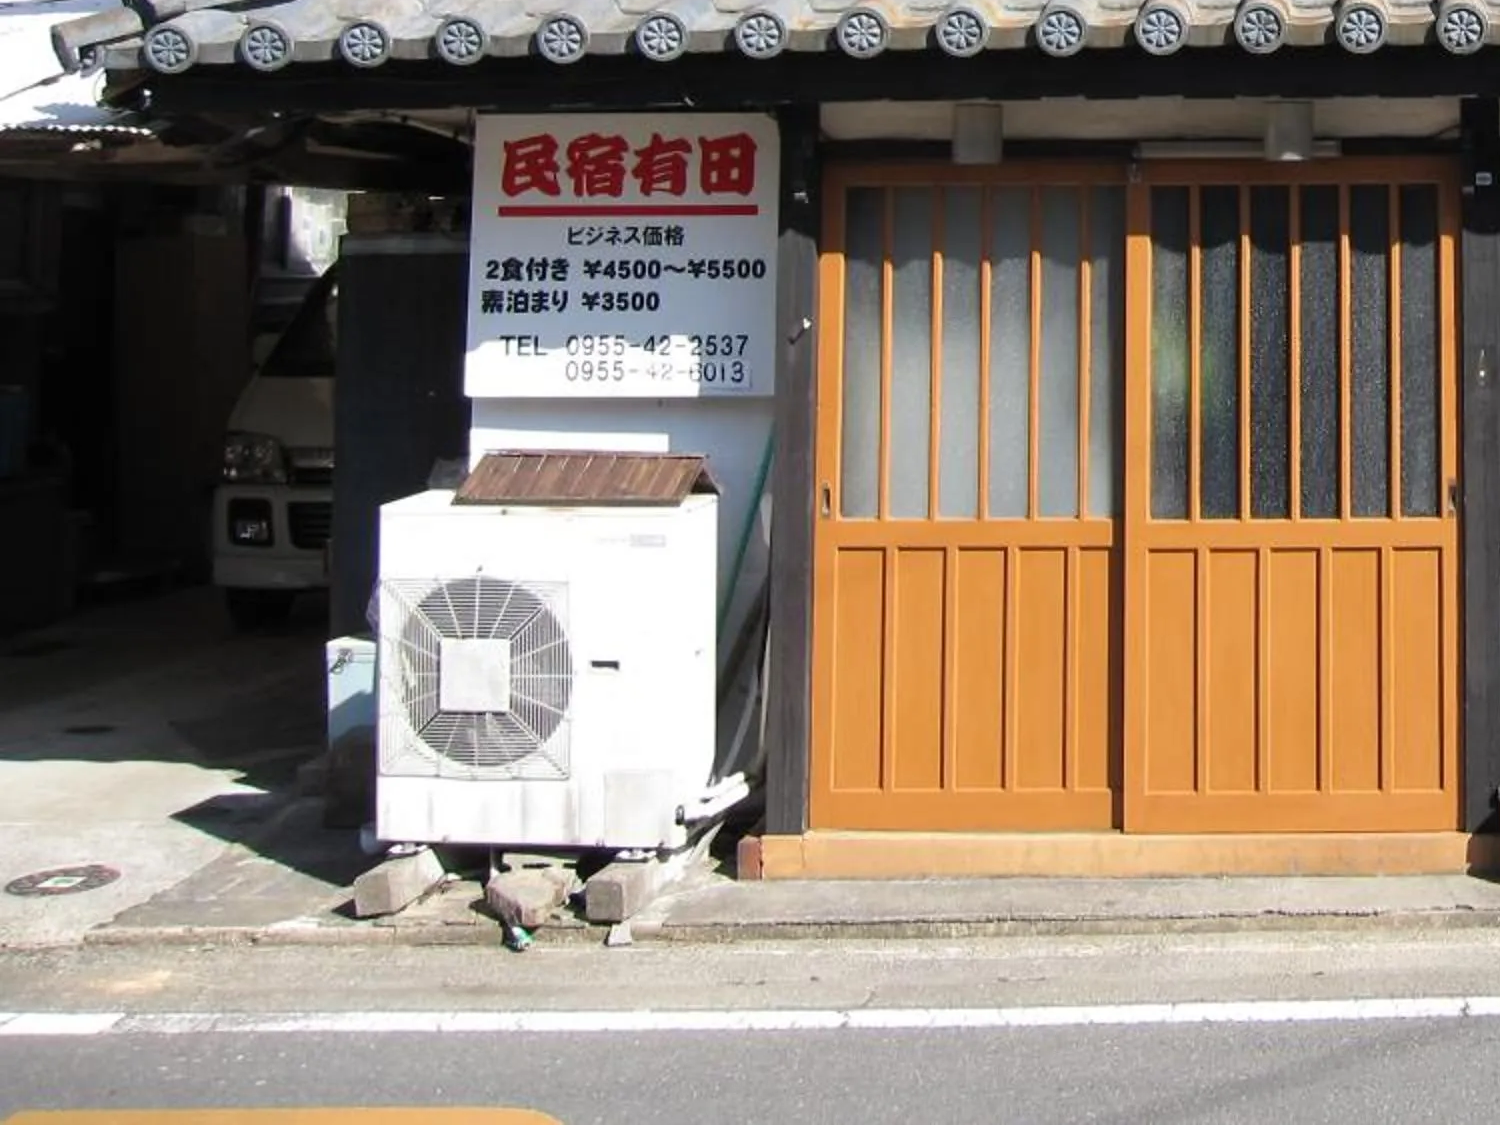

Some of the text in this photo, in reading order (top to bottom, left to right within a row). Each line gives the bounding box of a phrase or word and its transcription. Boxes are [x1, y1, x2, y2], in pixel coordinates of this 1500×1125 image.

[501, 131, 758, 197] 民宿有田
[566, 225, 685, 246] ビジネス価格
[485, 257, 571, 282] 2食付き
[481, 290, 660, 314] 素泊まり ¥3500
[499, 334, 749, 357] TEL 0955-42-2537
